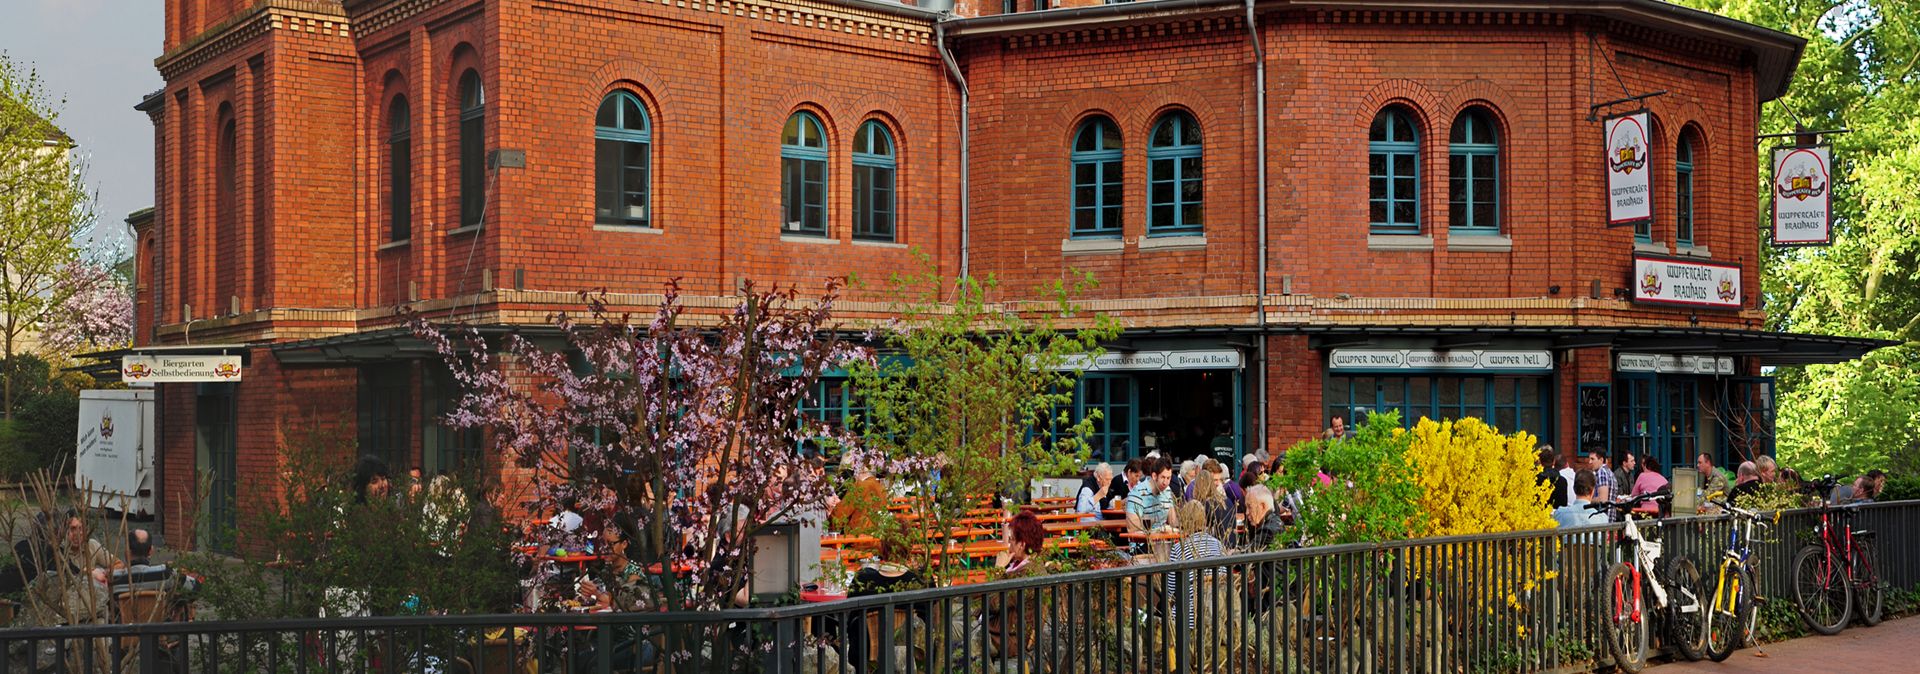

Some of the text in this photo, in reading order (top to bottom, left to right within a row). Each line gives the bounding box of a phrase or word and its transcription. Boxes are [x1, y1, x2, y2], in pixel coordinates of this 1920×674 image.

[163, 359, 205, 368] Biergarten
[1202, 355, 1210, 363] &
[1211, 355, 1231, 364] Back
[151, 369, 214, 377] Selbstbedienung
